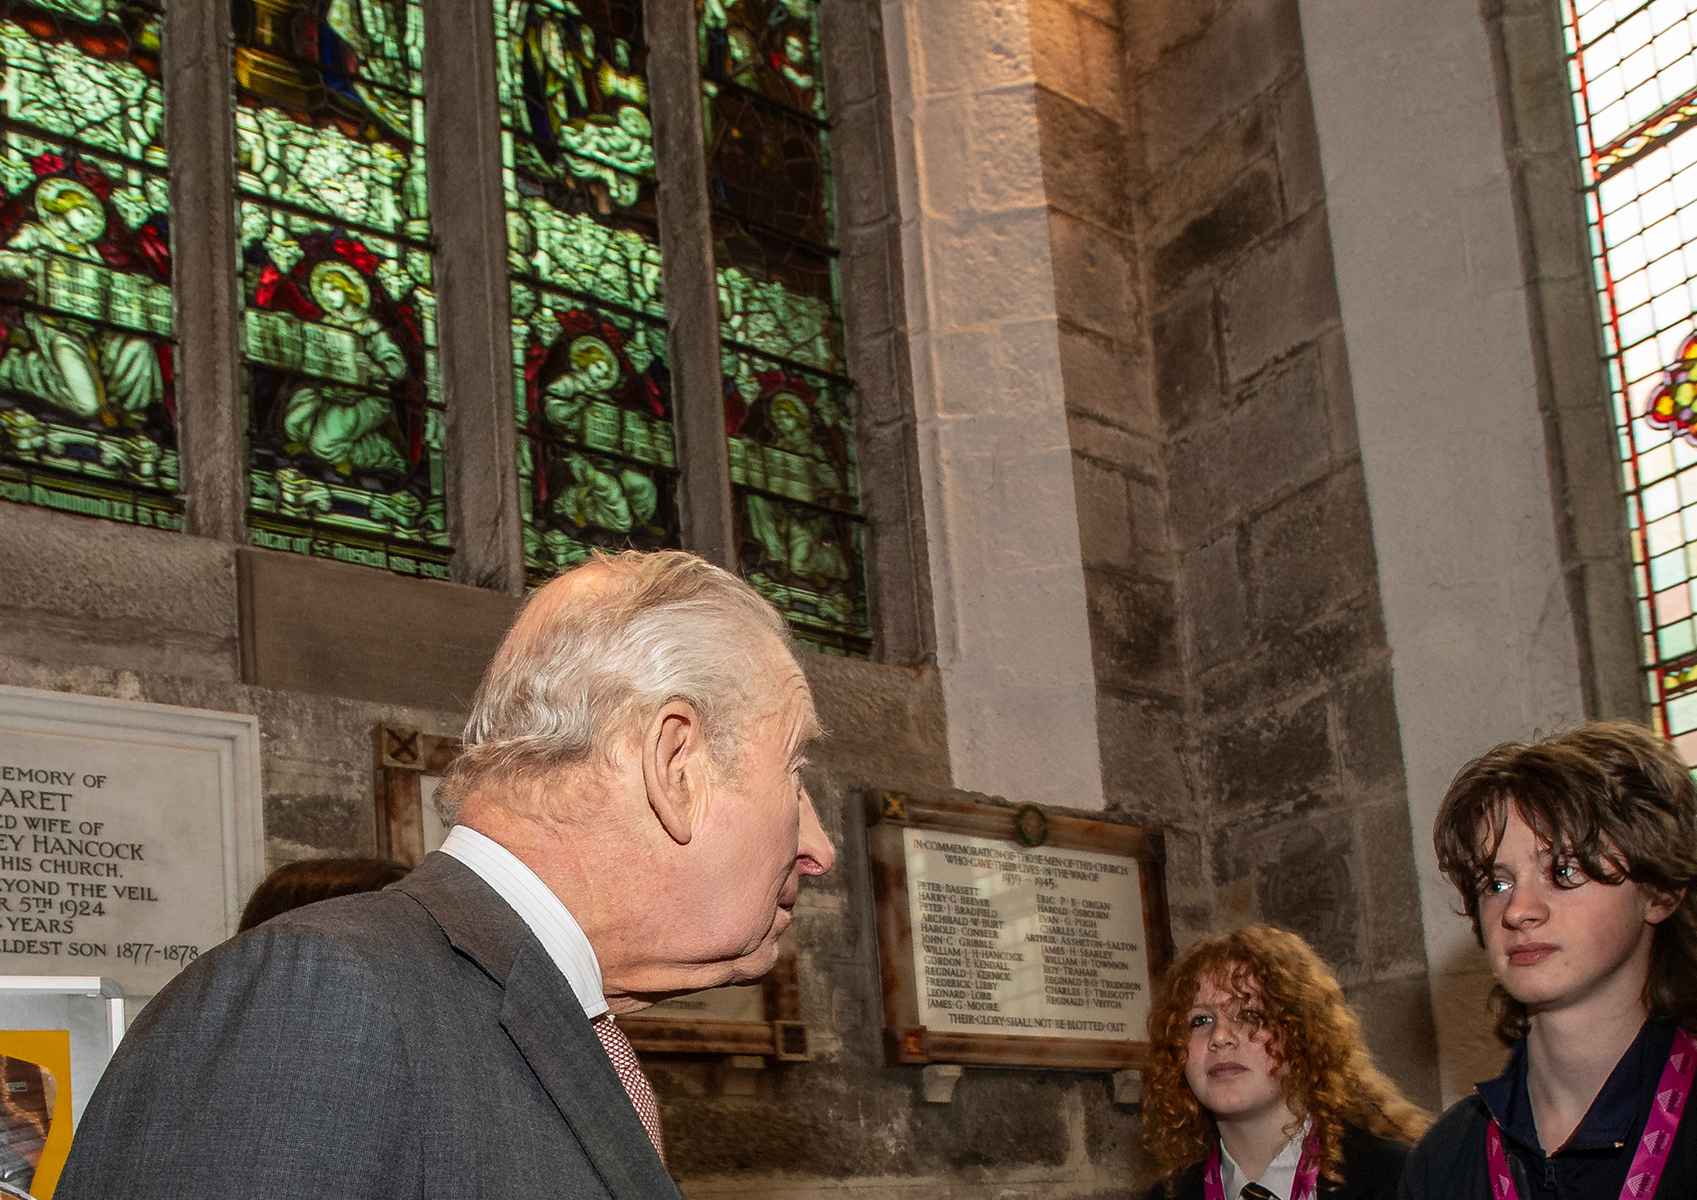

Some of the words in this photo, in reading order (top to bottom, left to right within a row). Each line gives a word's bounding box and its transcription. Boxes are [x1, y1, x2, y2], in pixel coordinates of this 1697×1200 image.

[82, 774, 107, 788] OF
[22, 816, 72, 833] WIFE
[79, 821, 104, 836] OF
[33, 834, 144, 861] HANCOCK
[39, 859, 123, 878] CHURCH.
[0, 878, 60, 896] YOND
[66, 882, 107, 898] THE
[112, 885, 159, 902] VEIL
[59, 899, 106, 919] 1924
[6, 916, 74, 934] YEARS
[0, 939, 63, 955] LDEST
[67, 942, 107, 957] SON
[116, 942, 199, 968] 1877-1878
